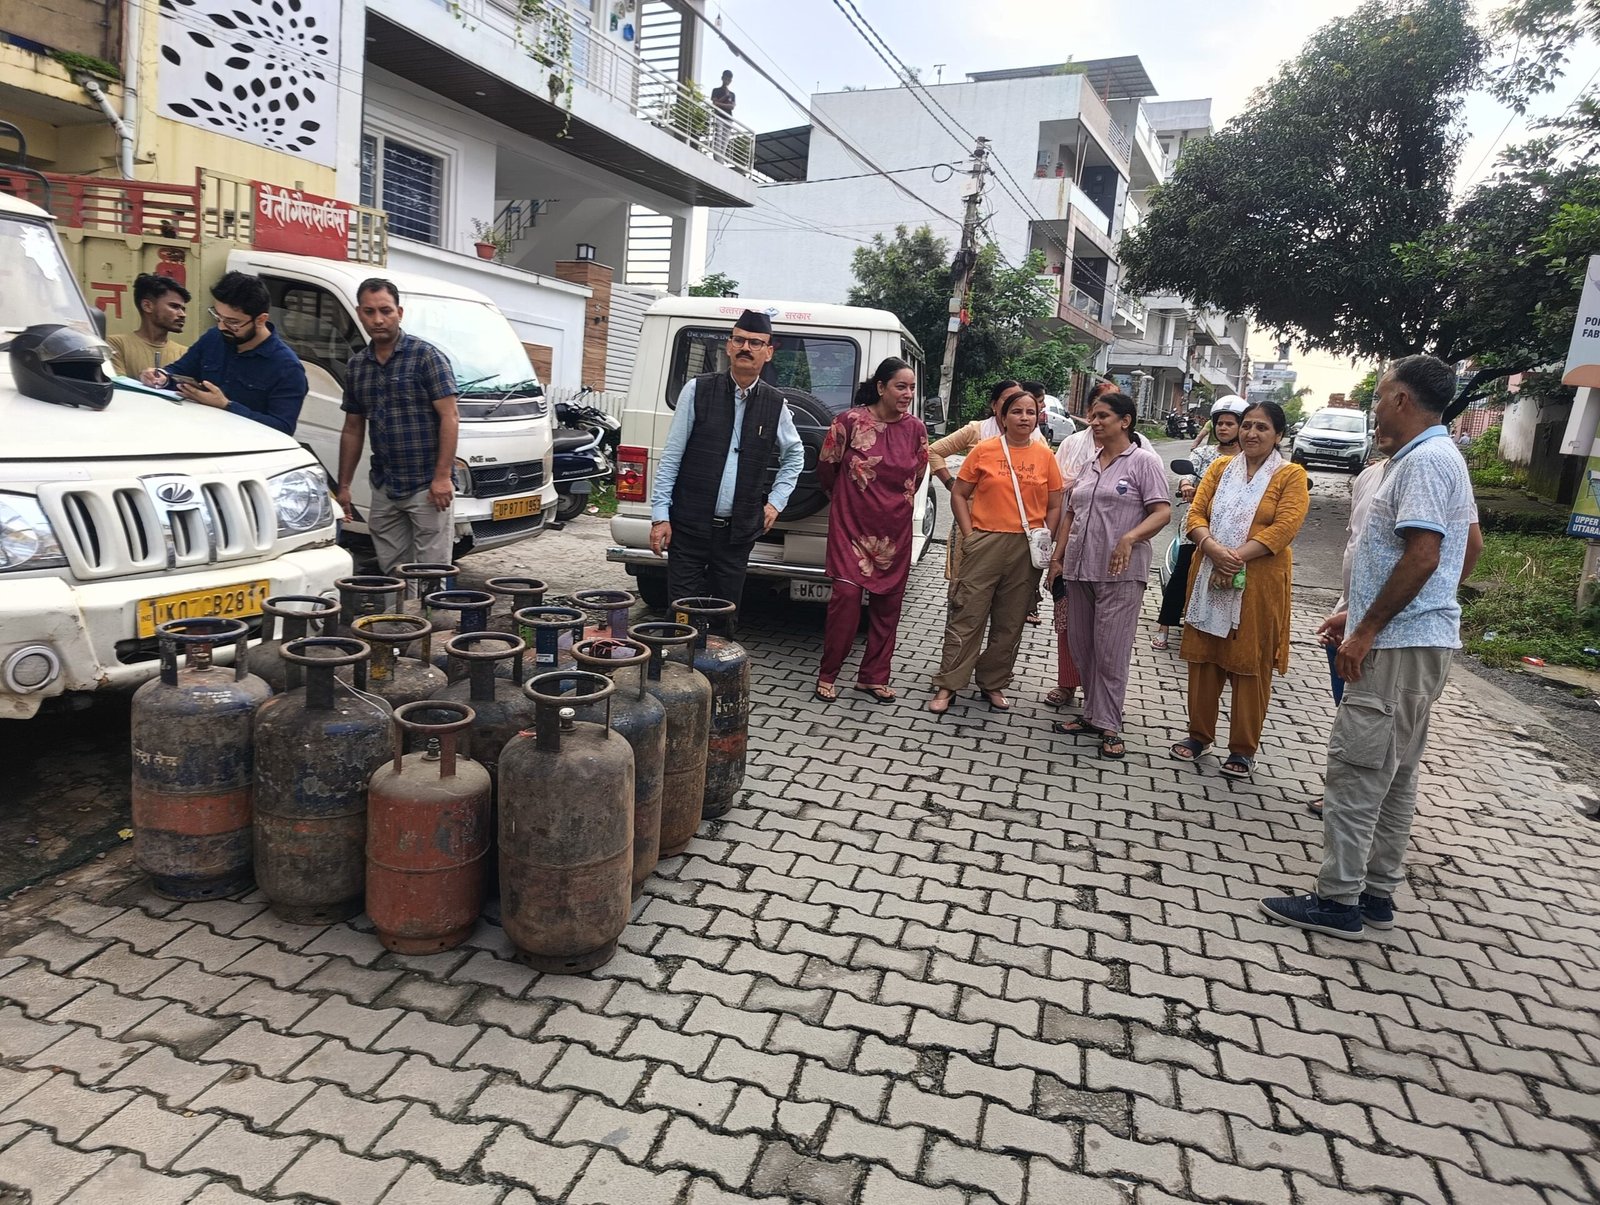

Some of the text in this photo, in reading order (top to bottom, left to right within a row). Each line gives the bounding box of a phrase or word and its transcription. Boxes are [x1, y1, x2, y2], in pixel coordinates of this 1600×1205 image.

[784, 311, 811, 320] सरकार
[1582, 328, 1600, 338] FAB
[1574, 515, 1599, 526] UPPER
